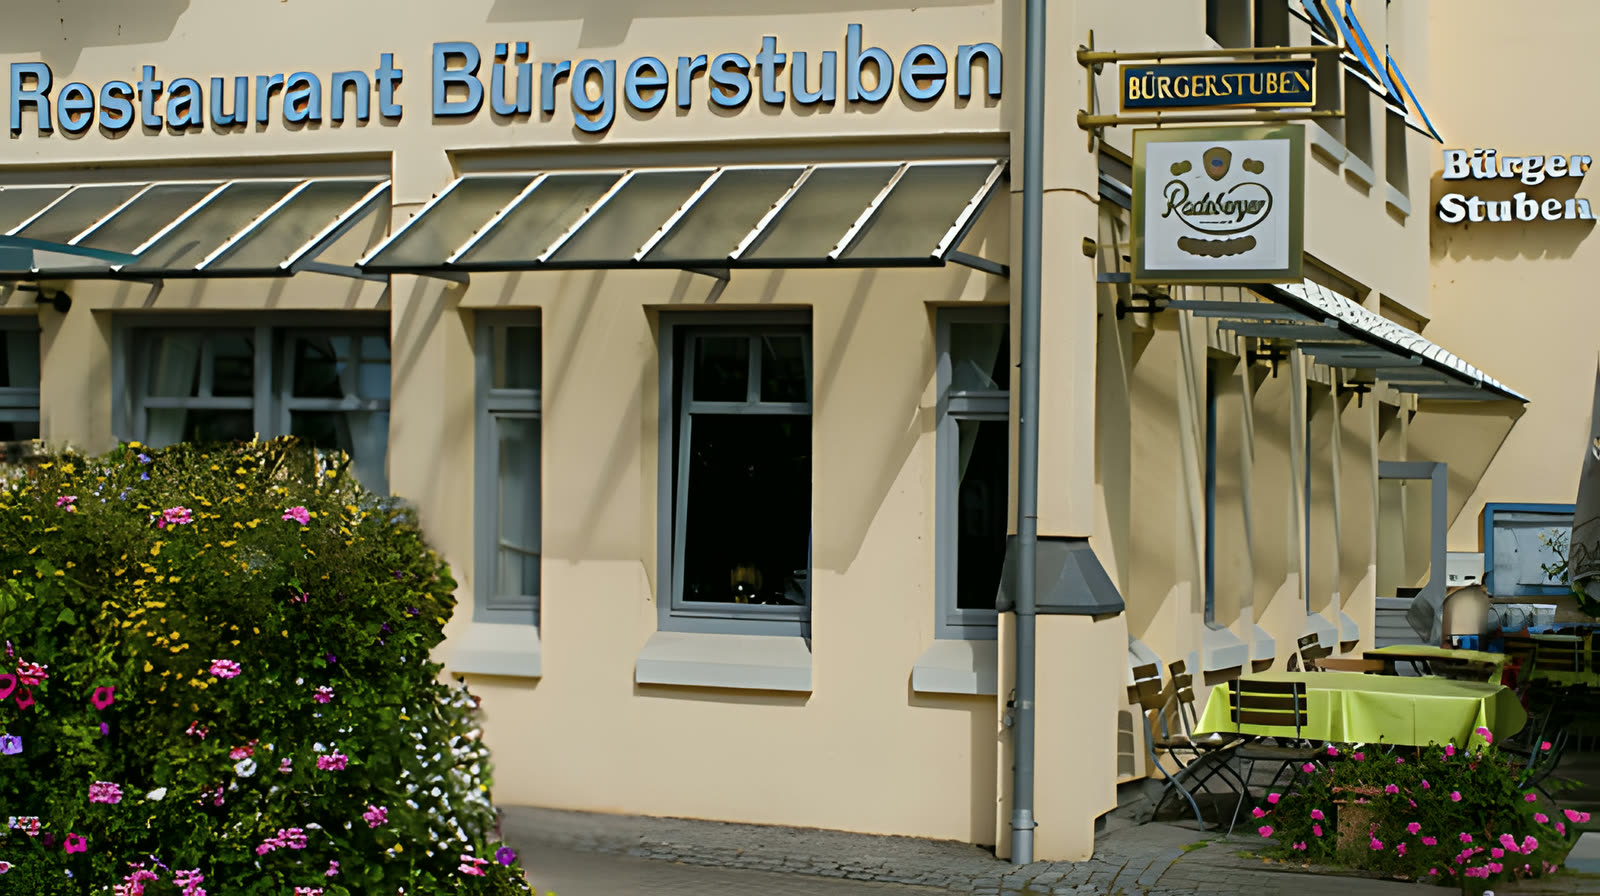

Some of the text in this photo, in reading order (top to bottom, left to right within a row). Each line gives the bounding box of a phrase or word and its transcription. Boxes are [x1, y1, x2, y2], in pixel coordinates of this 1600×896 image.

[10, 23, 1003, 132] Restaurant Bürgerstuben
[1128, 71, 1310, 100] BÜRGERSTUBEN
[1442, 148, 1593, 185] Bürger
[1438, 191, 1594, 223] Stuben
